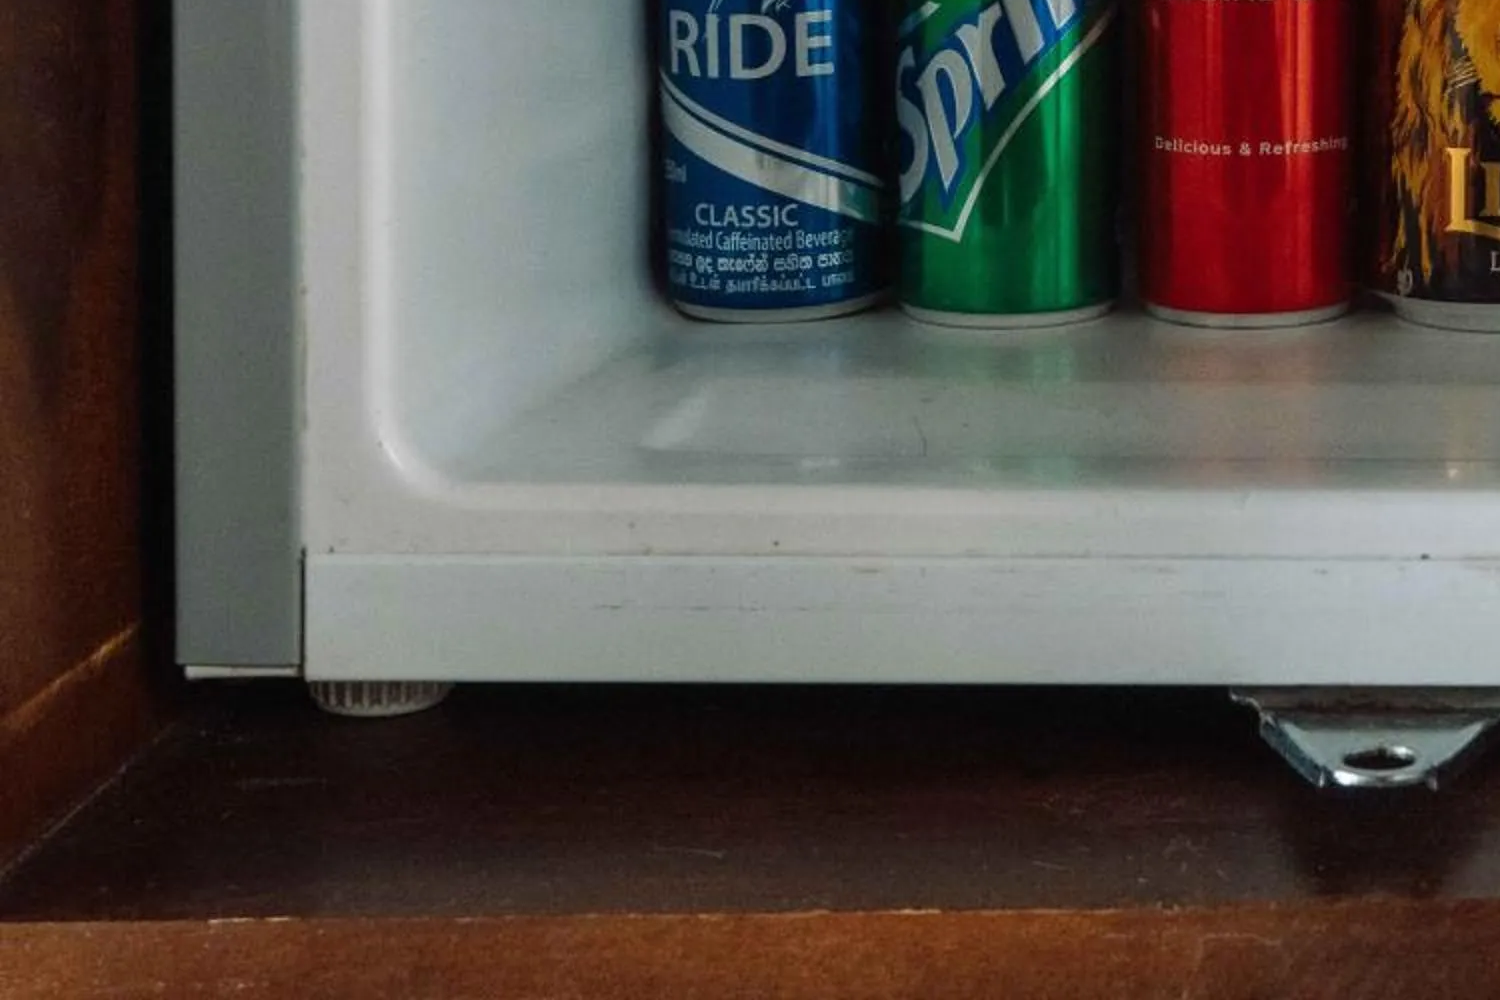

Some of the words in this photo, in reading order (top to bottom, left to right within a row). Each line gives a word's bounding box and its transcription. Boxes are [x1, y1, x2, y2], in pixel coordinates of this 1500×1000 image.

[668, 8, 835, 79] RIDE
[1155, 136, 1232, 157] Delicious
[1239, 142, 1252, 156] &
[695, 203, 799, 228] CLASSIC
[716, 229, 793, 252] Caffeinated
